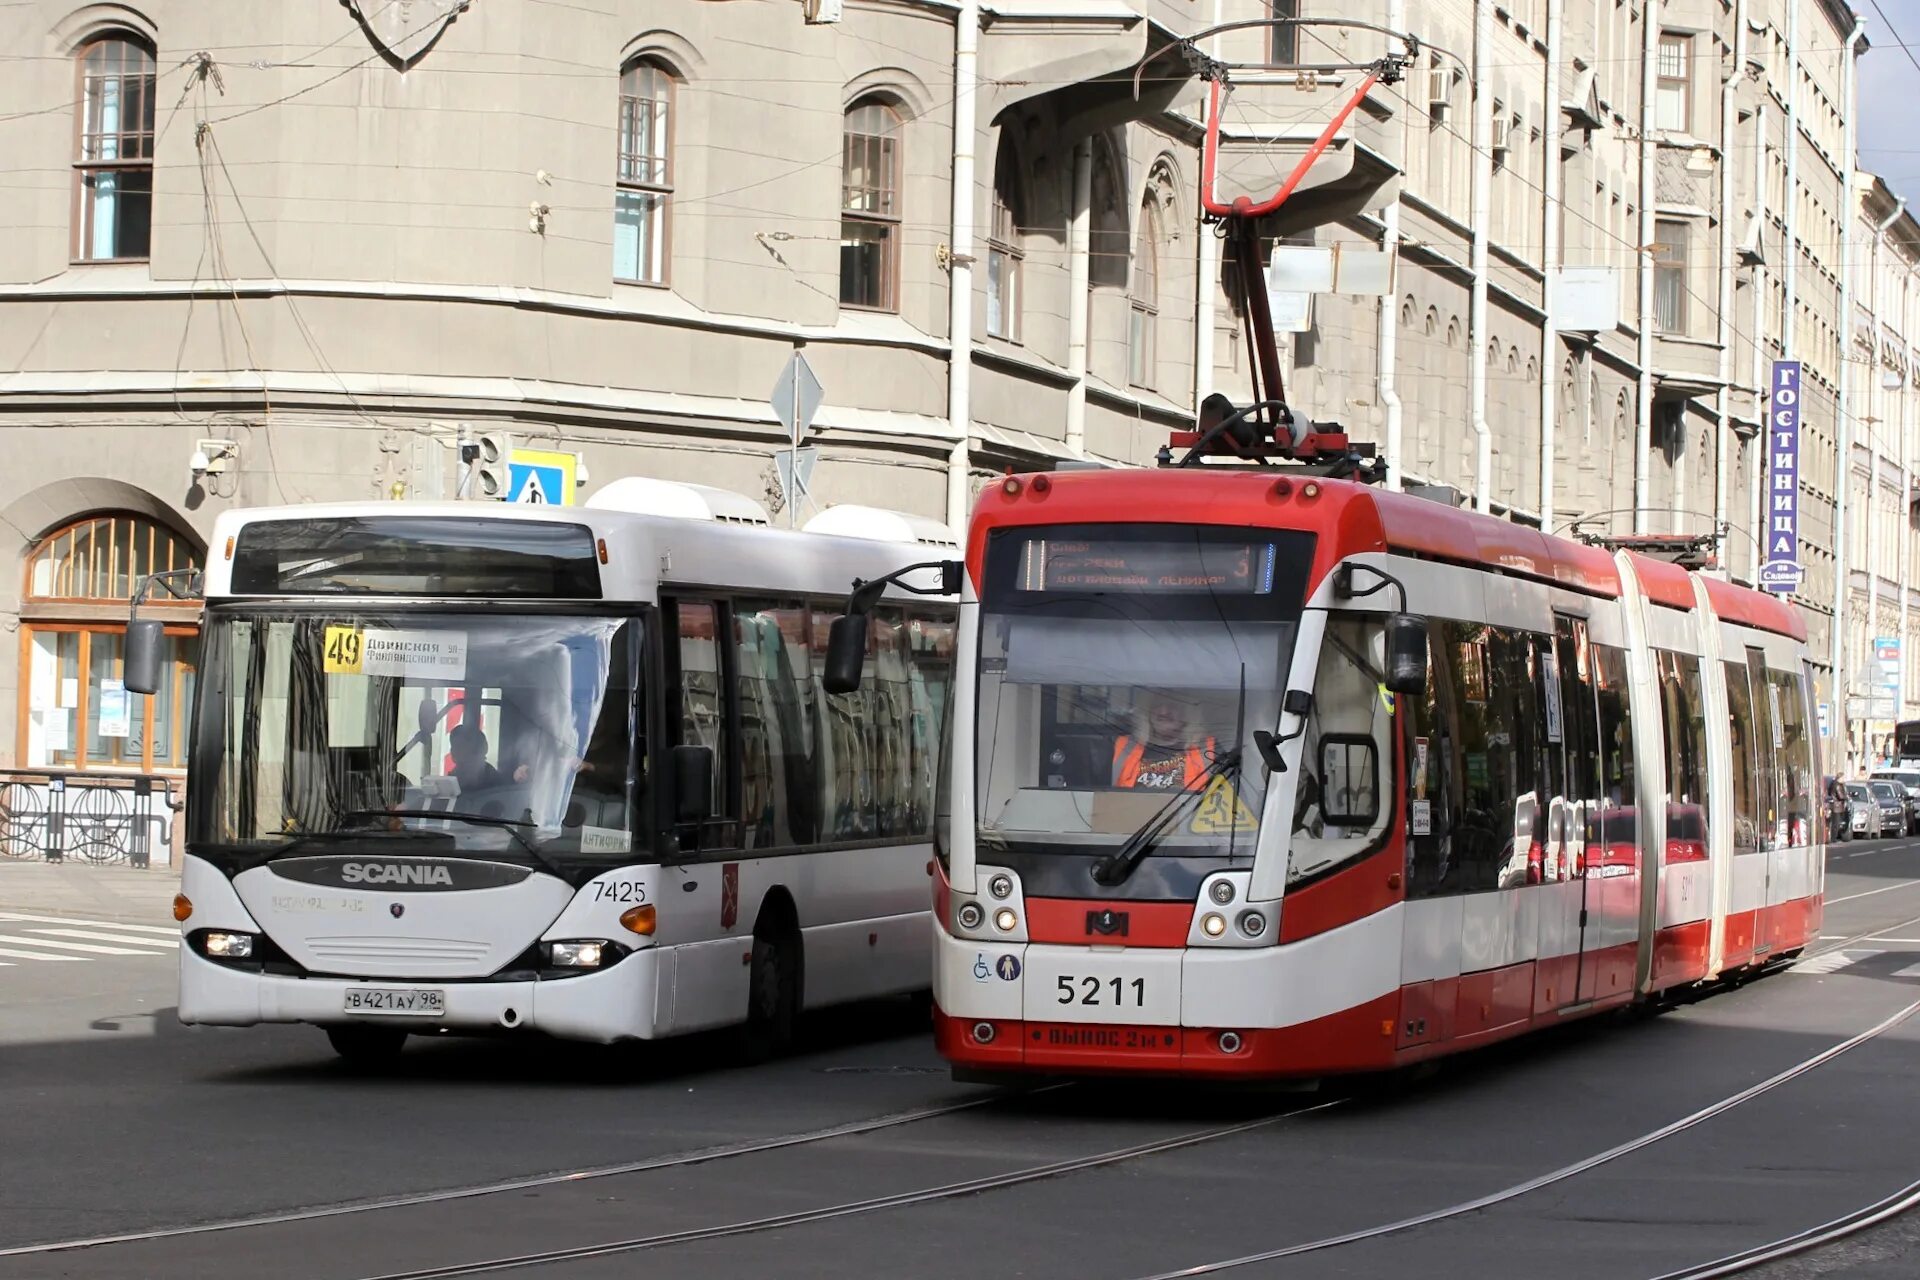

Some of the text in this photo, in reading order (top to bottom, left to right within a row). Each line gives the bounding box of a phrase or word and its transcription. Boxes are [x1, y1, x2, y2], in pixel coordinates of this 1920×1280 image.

[1773, 369, 1795, 553] ГОСТИНИЦА
[327, 632, 360, 665] 49
[341, 862, 454, 886] SCANIA
[593, 881, 646, 903] 7425
[1057, 976, 1146, 1007] 5211
